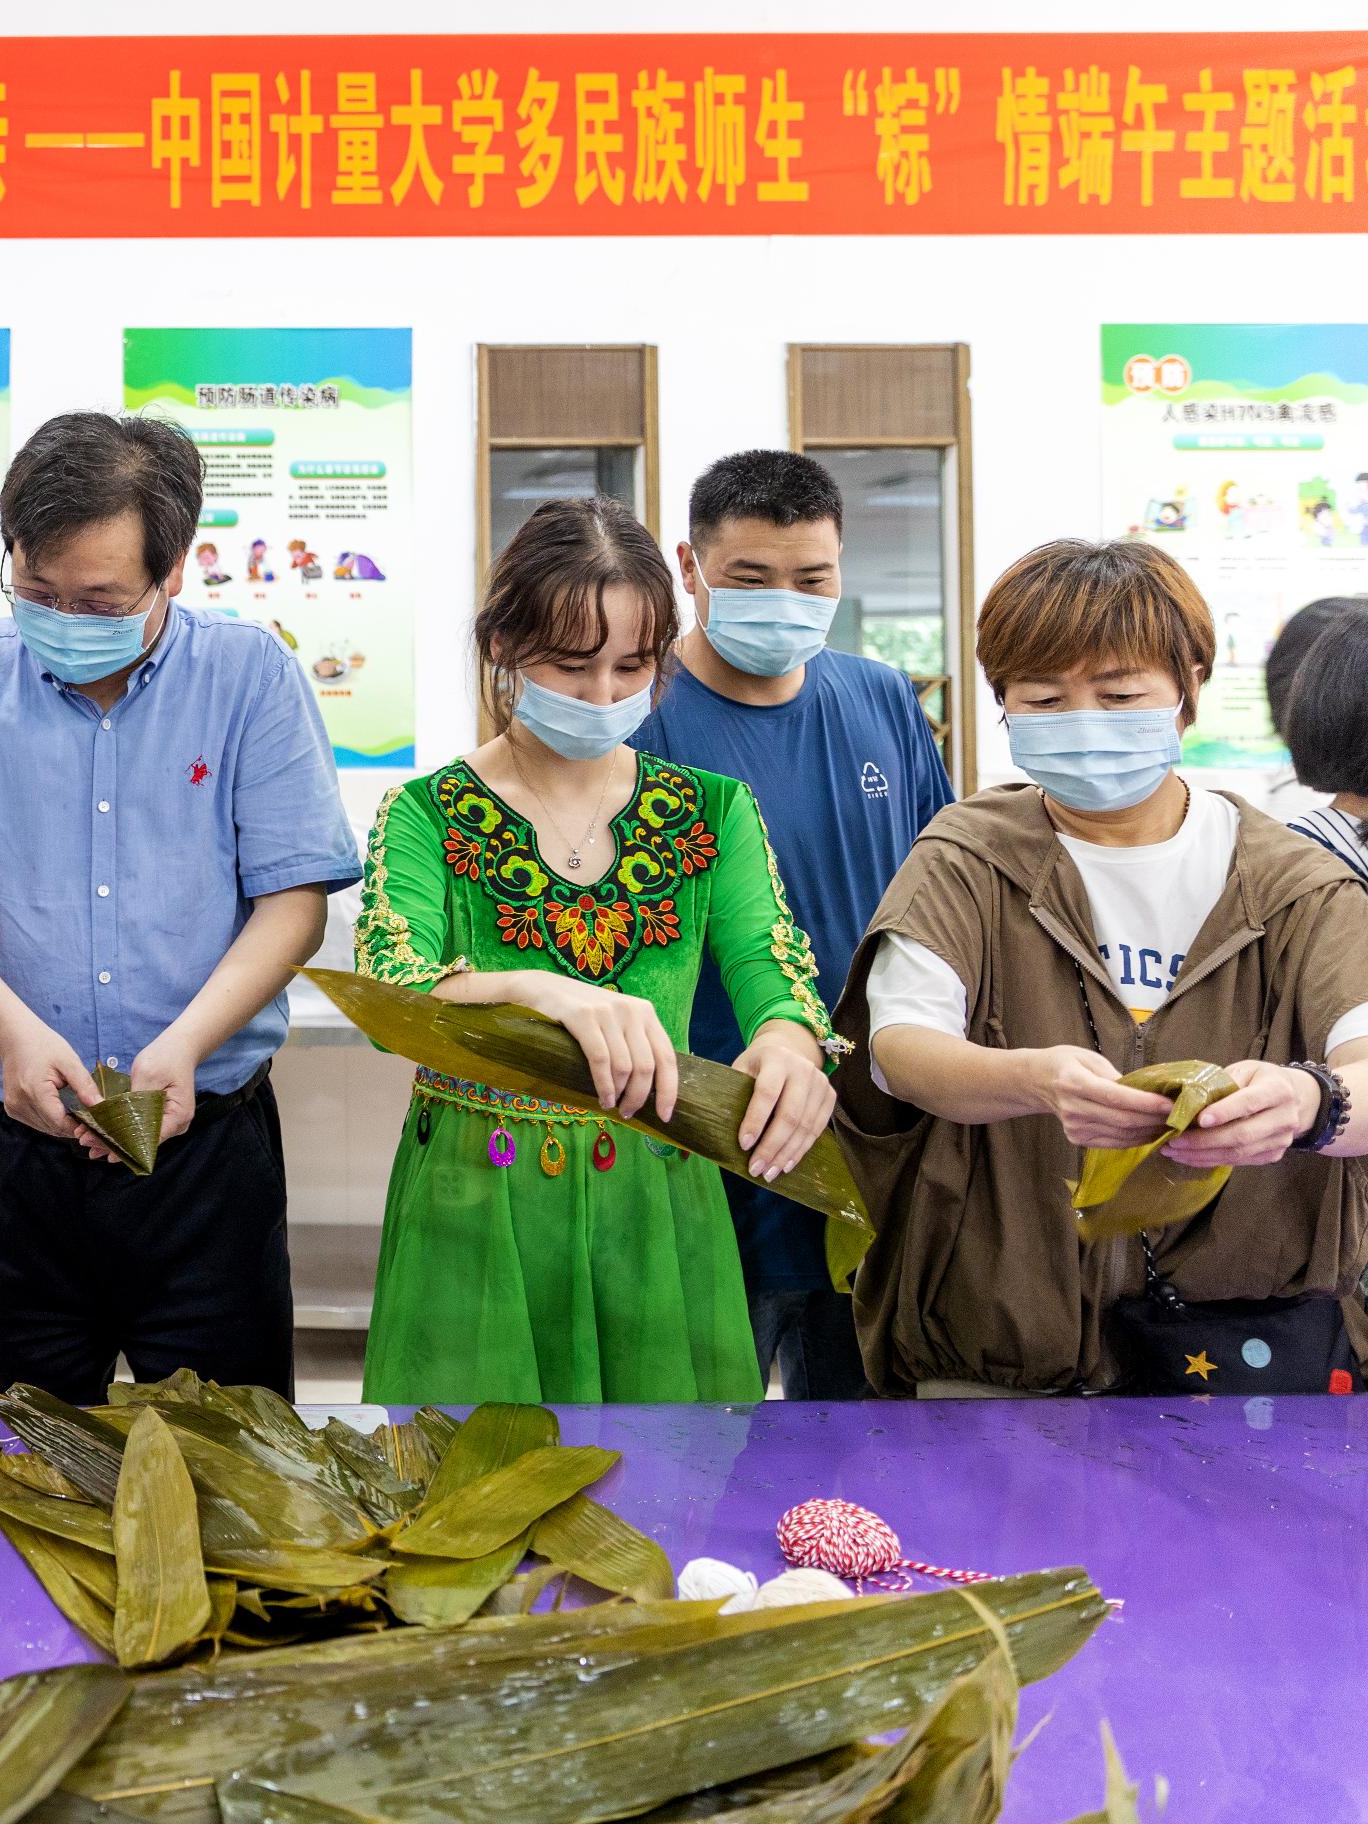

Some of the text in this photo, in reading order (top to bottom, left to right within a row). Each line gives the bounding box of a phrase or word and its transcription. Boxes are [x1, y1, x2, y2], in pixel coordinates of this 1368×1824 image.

[198, 385, 338, 407] 预防肠道传染病
